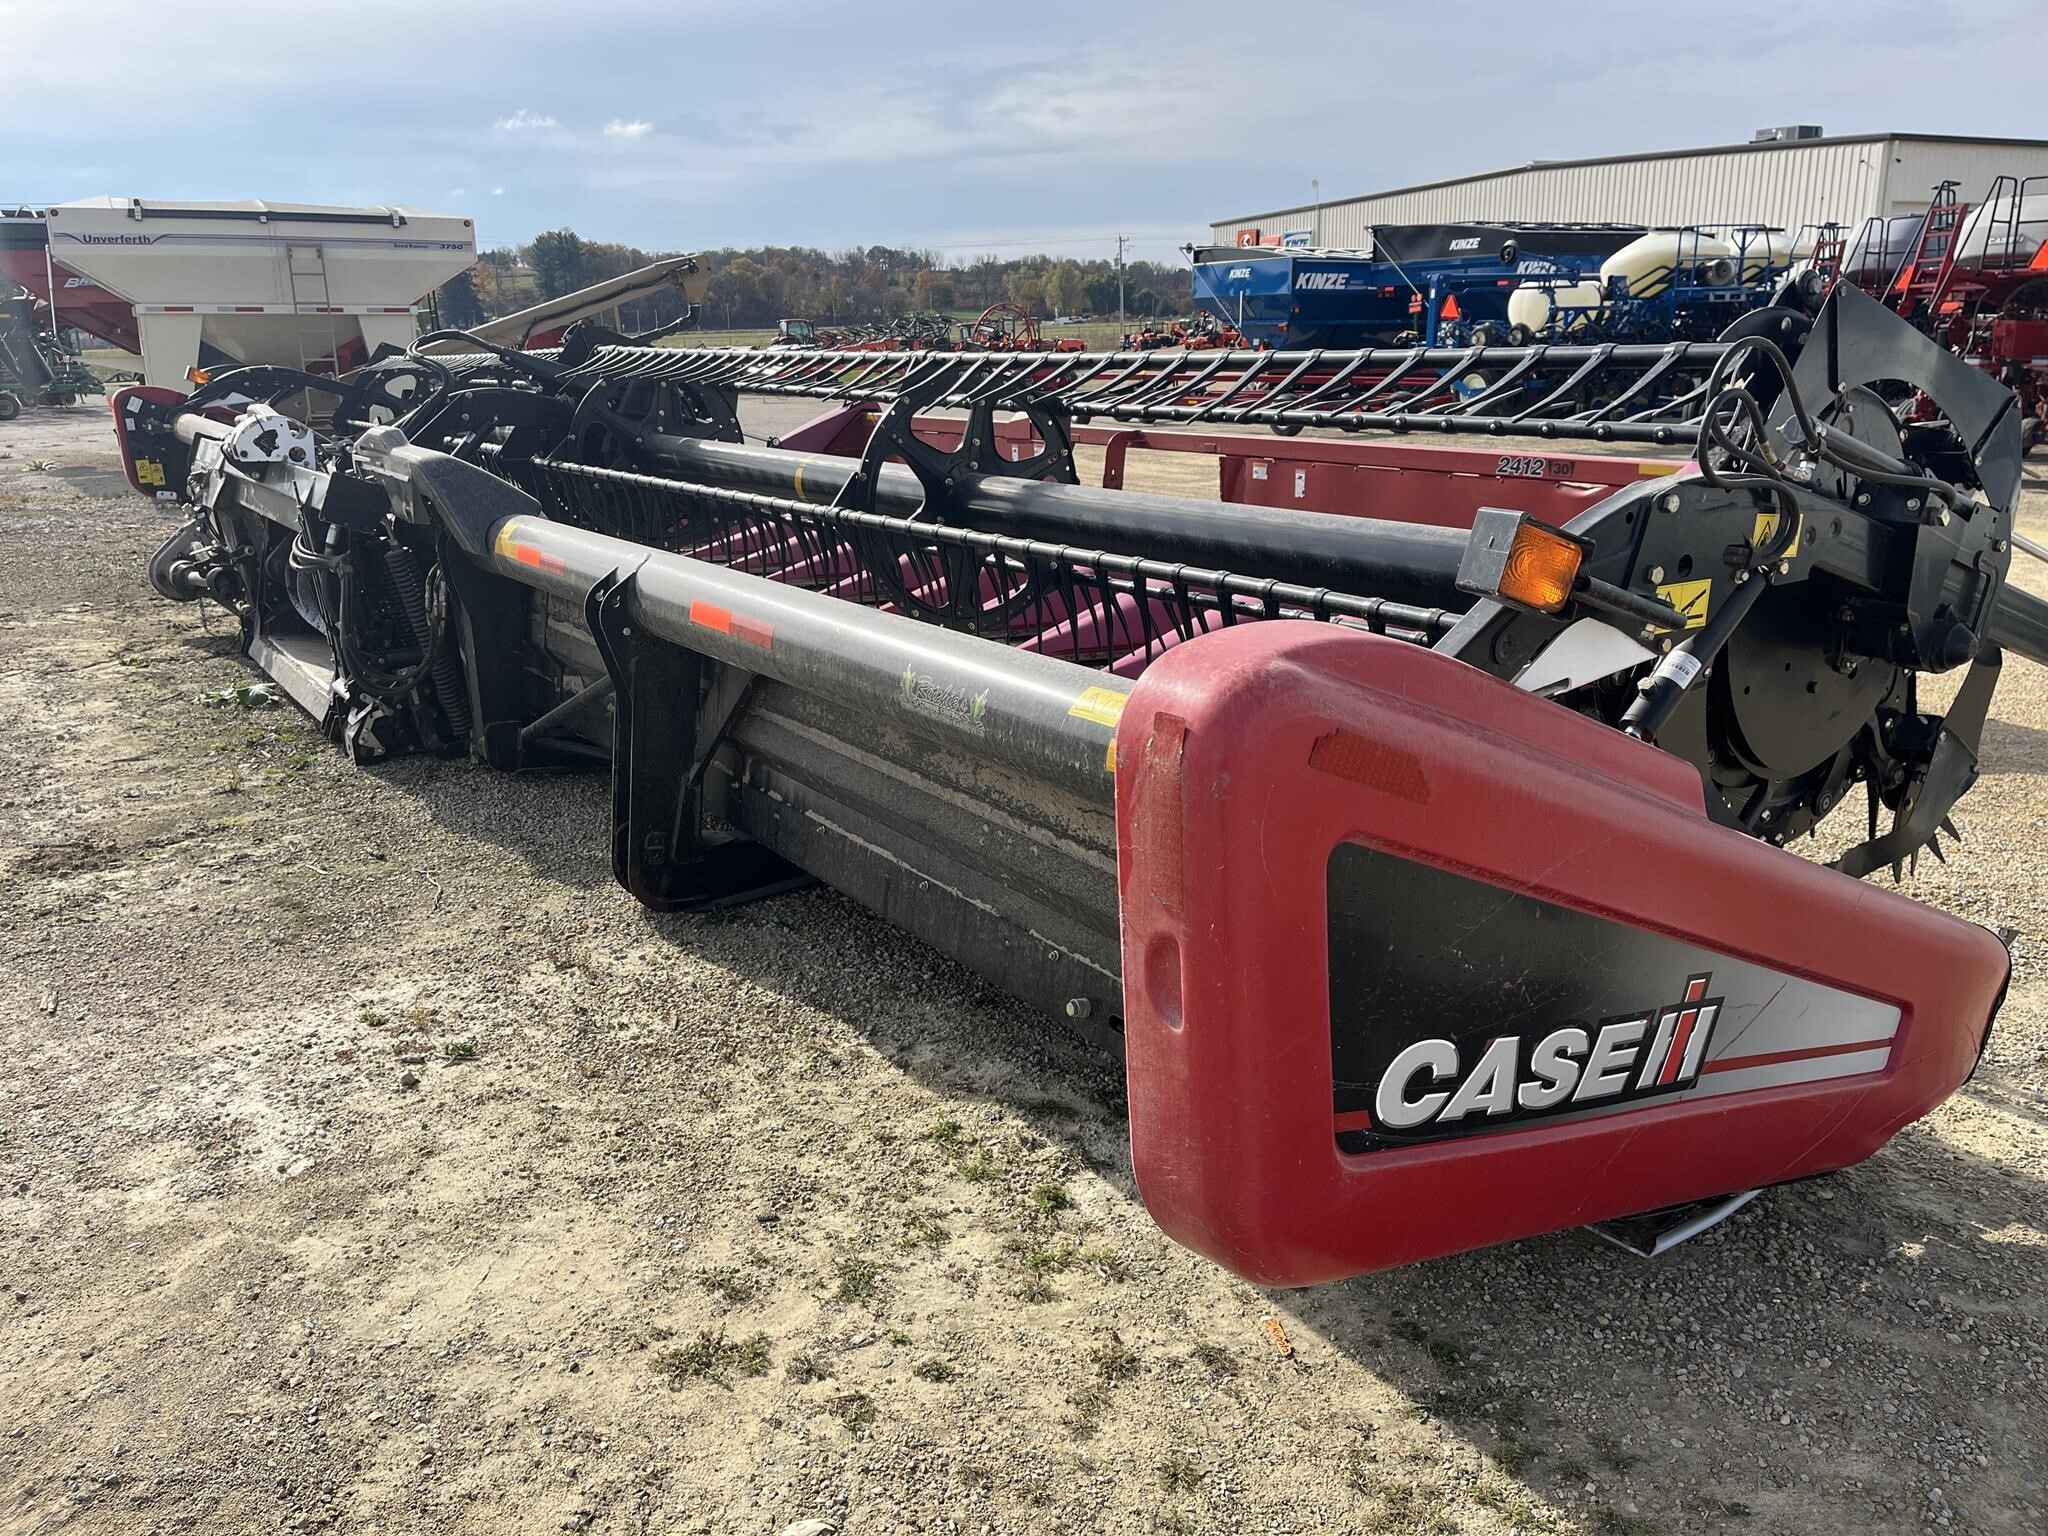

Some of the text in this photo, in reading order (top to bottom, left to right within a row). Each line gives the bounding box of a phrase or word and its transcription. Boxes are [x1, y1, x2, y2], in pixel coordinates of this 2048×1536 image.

[82, 234, 151, 244] Unverferth
[1449, 238, 1481, 251] KINZE
[1229, 268, 1251, 279] KINZE
[1295, 273, 1349, 290] KINZE
[1496, 456, 1545, 477] 2412
[1553, 463, 1570, 475] 30
